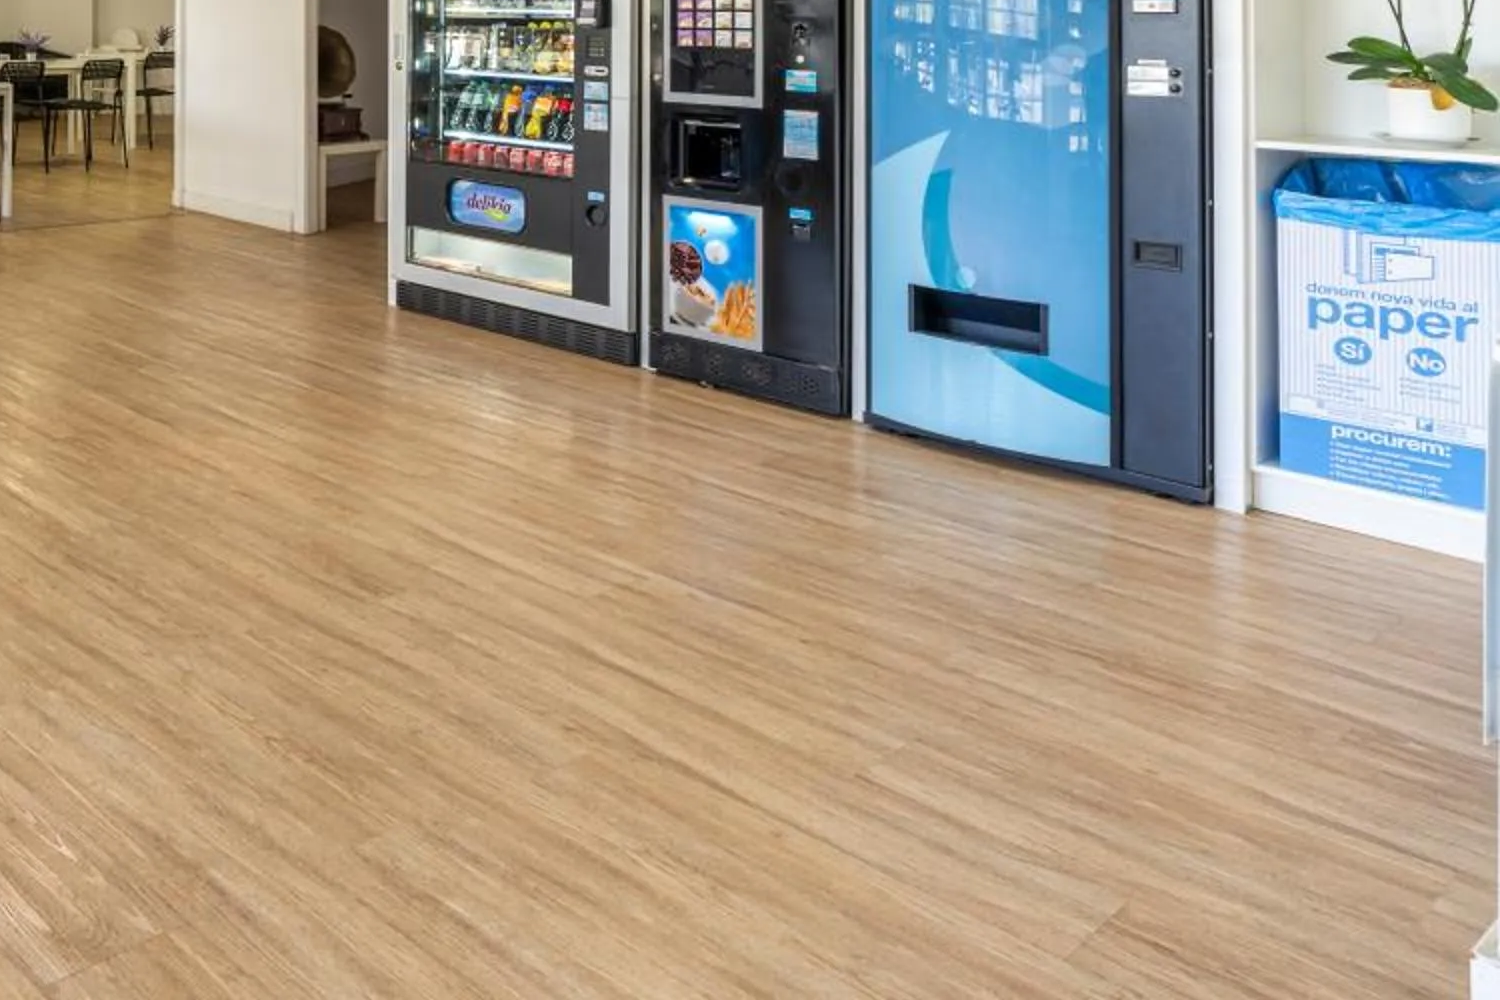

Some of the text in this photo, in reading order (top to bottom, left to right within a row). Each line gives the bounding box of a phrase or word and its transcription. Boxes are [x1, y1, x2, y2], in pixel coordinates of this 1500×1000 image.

[1306, 282, 1479, 313] donom nova vida al
[1308, 296, 1479, 342] paper
[1409, 353, 1446, 372] No
[1331, 425, 1453, 457] procurem:
